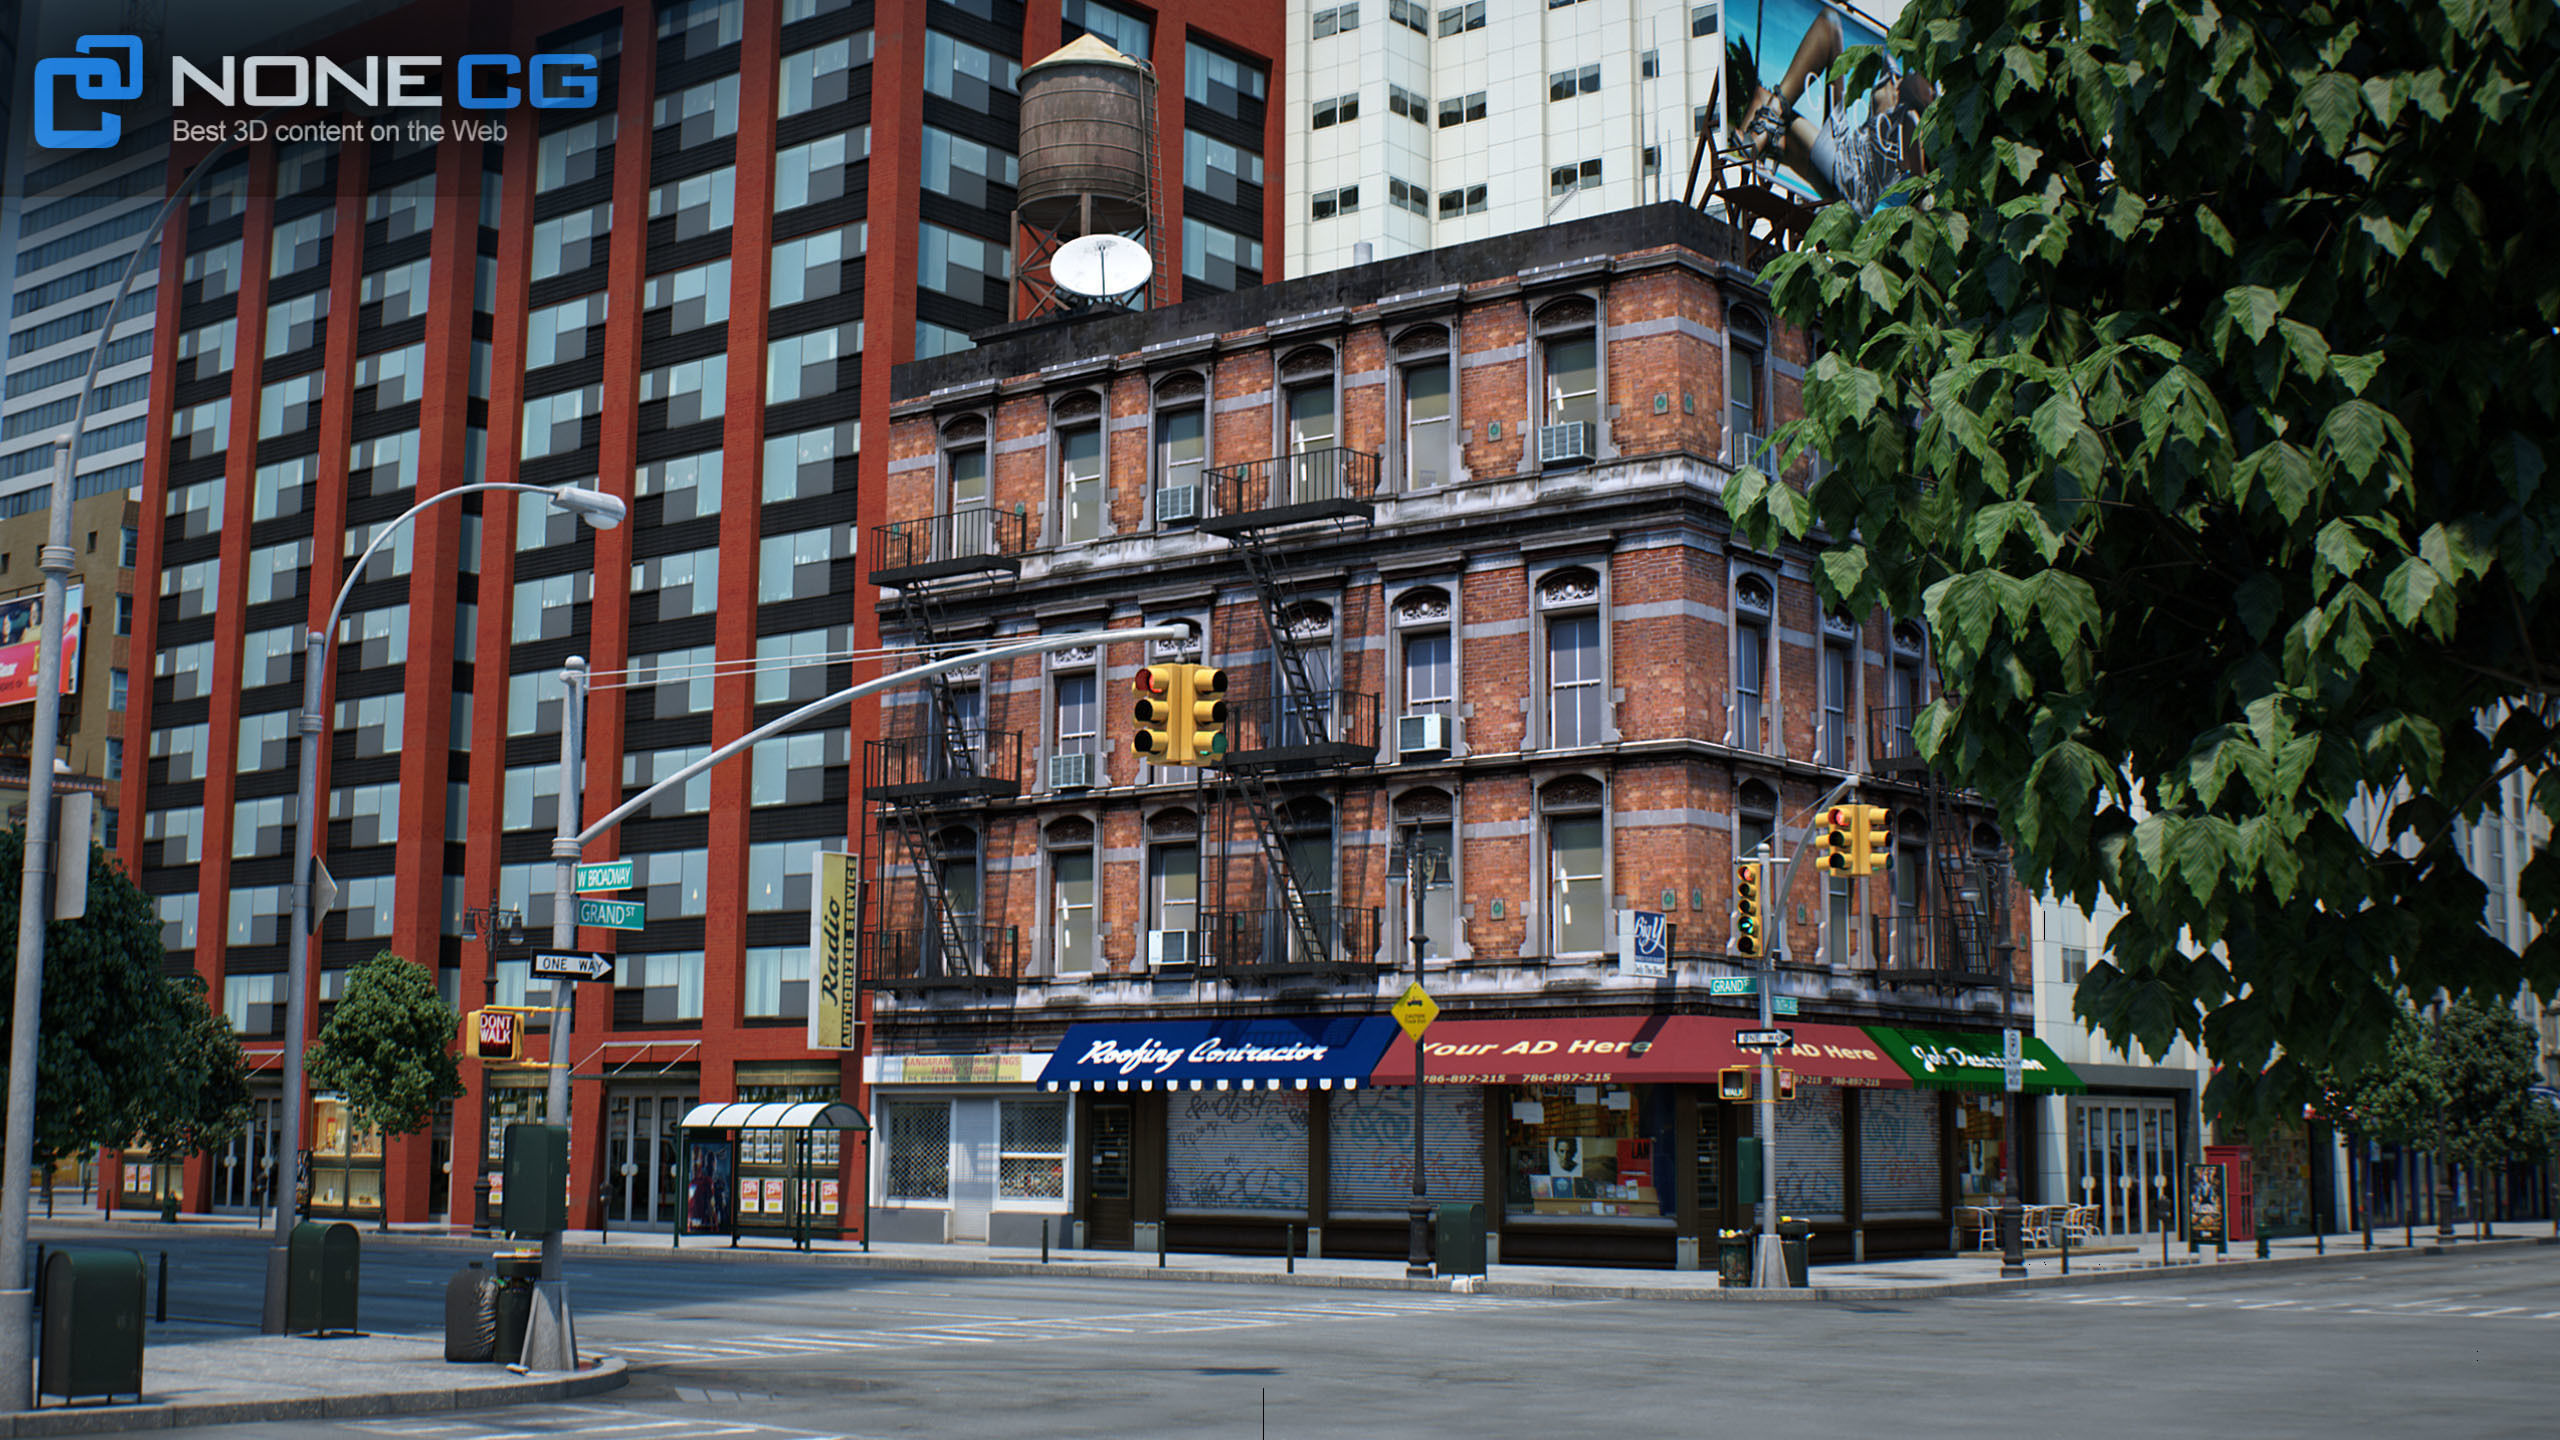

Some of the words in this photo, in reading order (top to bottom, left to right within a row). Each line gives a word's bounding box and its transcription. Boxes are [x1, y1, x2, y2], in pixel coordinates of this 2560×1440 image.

[577, 870, 587, 888] W
[588, 867, 631, 887] BROADWAY
[845, 856, 858, 931] SERVICE
[581, 903, 625, 924] GRAND
[625, 906, 635, 917] ST
[822, 896, 841, 1007] Radio
[542, 957, 568, 970] ONE
[578, 959, 603, 972] WAY
[842, 936, 855, 1048] AUTHORIZED
[1713, 979, 1744, 993] GRAND
[480, 1015, 513, 1030] DONT
[480, 1029, 512, 1044] WALK
[1743, 1033, 1760, 1043] ONE
[1502, 1040, 1558, 1055] AD
[1567, 1040, 1653, 1054] Here
[1791, 1043, 1821, 1057] AD
[1823, 1045, 1879, 1061] Here
[1077, 1038, 1185, 1075] Roofing
[1187, 1037, 1329, 1063] Contractor
[1911, 1044, 1949, 1073] Job
[1522, 1073, 1612, 1083] 786-897-215
[1724, 1088, 1744, 1097] WALK
